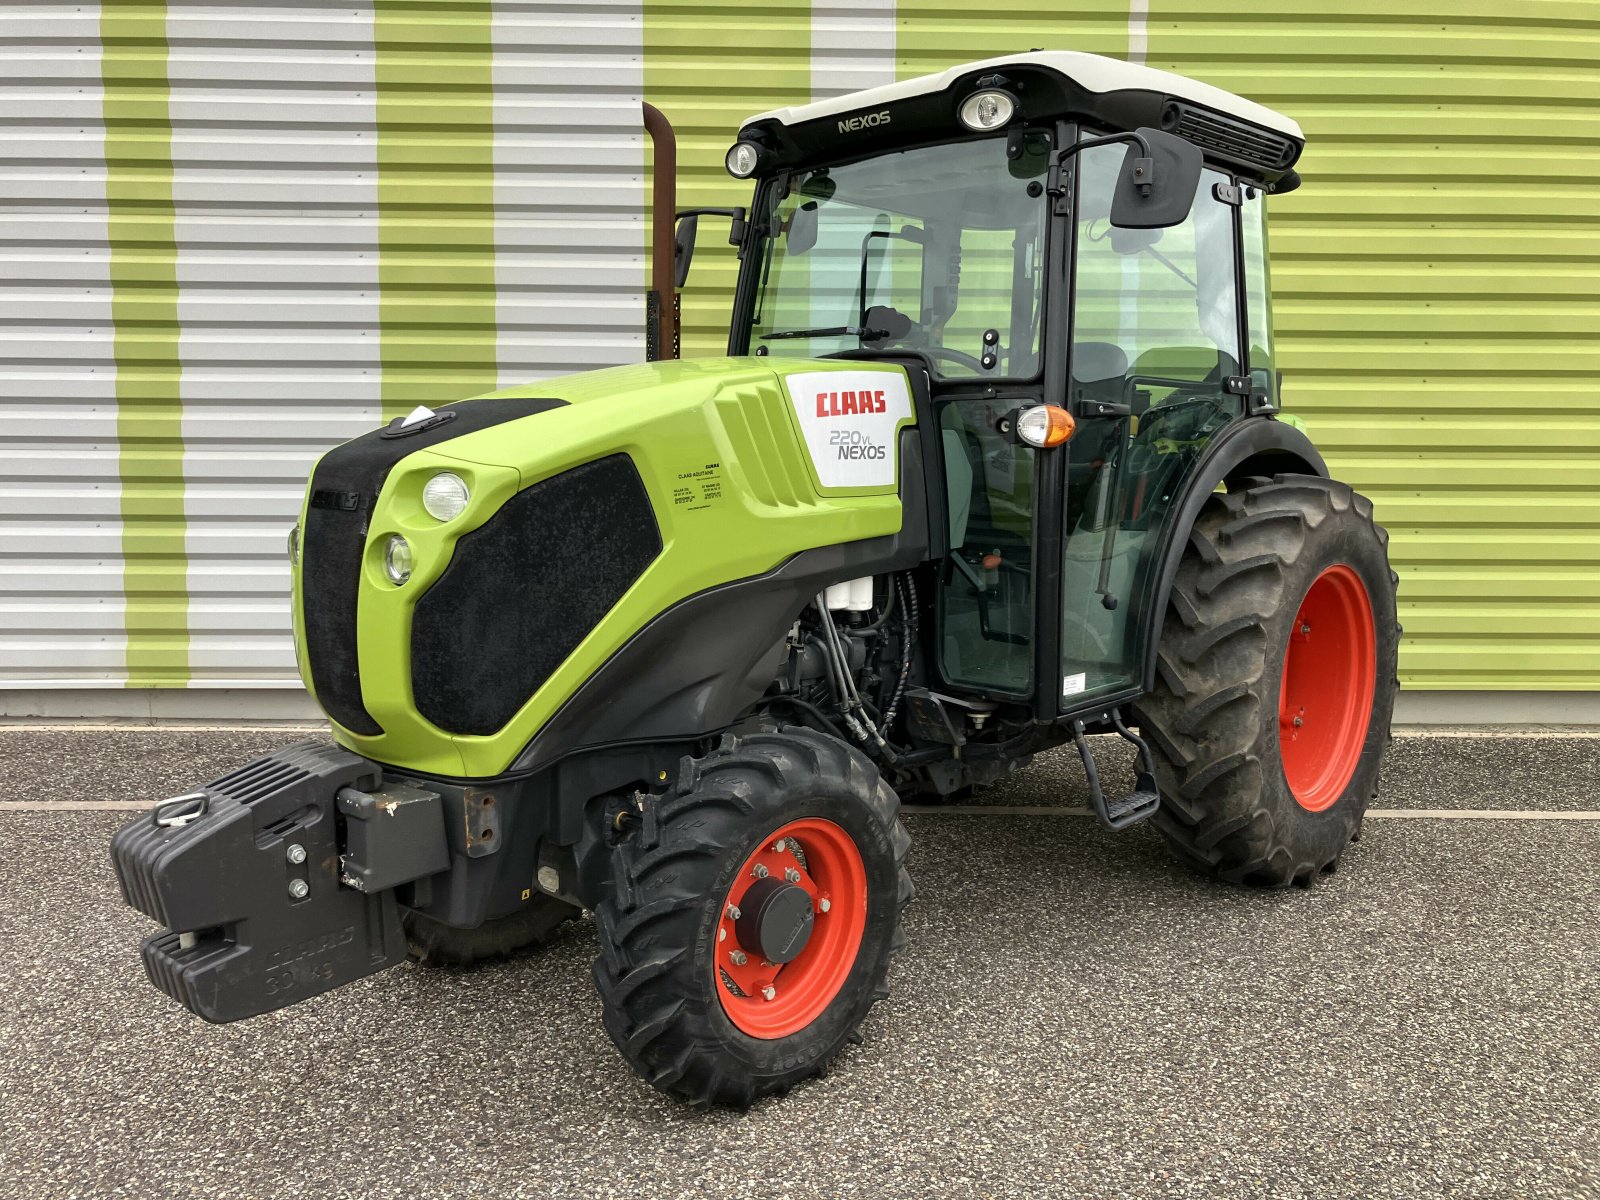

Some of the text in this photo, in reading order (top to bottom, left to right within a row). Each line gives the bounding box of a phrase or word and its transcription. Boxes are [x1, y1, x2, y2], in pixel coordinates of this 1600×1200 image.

[838, 110, 891, 134] NEXOS
[816, 390, 886, 417] CLAAS
[838, 445, 886, 461] NEXOS
